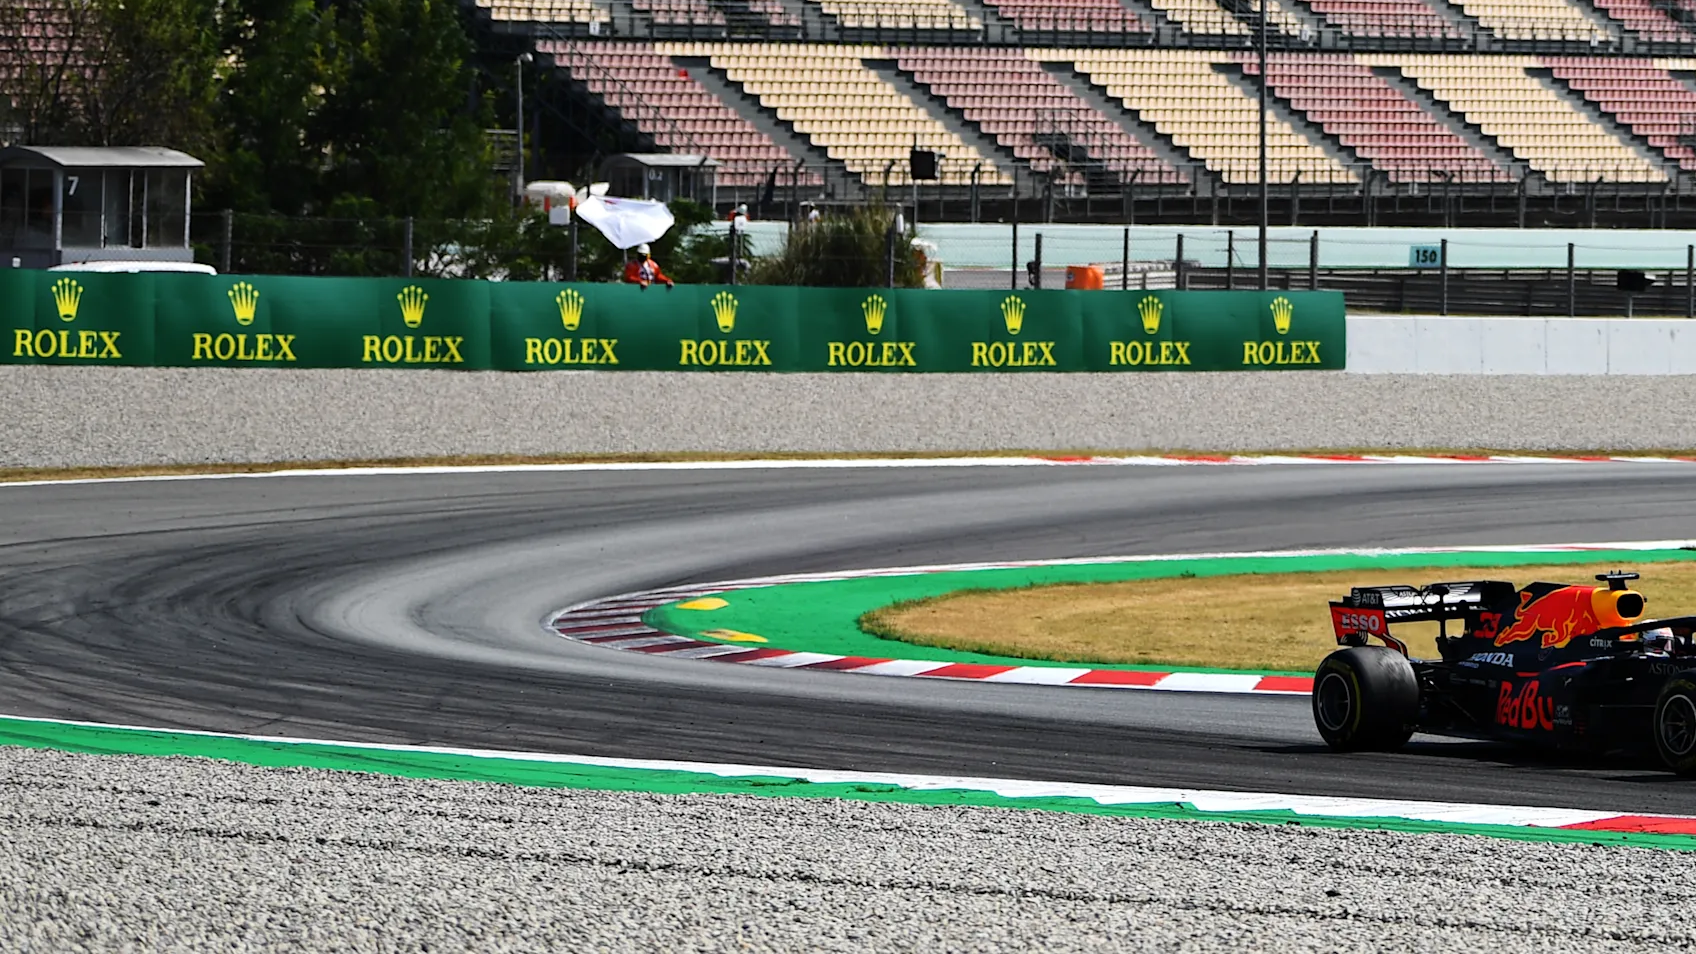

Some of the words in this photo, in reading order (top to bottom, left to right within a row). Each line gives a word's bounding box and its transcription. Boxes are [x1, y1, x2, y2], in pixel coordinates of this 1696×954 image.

[68, 176, 79, 195] 7
[1416, 249, 1437, 264] 150
[13, 329, 121, 359] ROLEX
[192, 333, 296, 361] ROLEX
[363, 335, 463, 363] ROLEX
[526, 337, 619, 365] ROLEX
[680, 339, 771, 366] ROLEX
[828, 341, 916, 366] ROLEX
[972, 341, 1056, 367] ROLEX
[1110, 340, 1191, 365] ROLEX
[1243, 341, 1321, 365] ROLEX
[1362, 592, 1381, 606] AT&T
[1341, 614, 1380, 631] ESSO
[1468, 652, 1514, 668] HONDA
